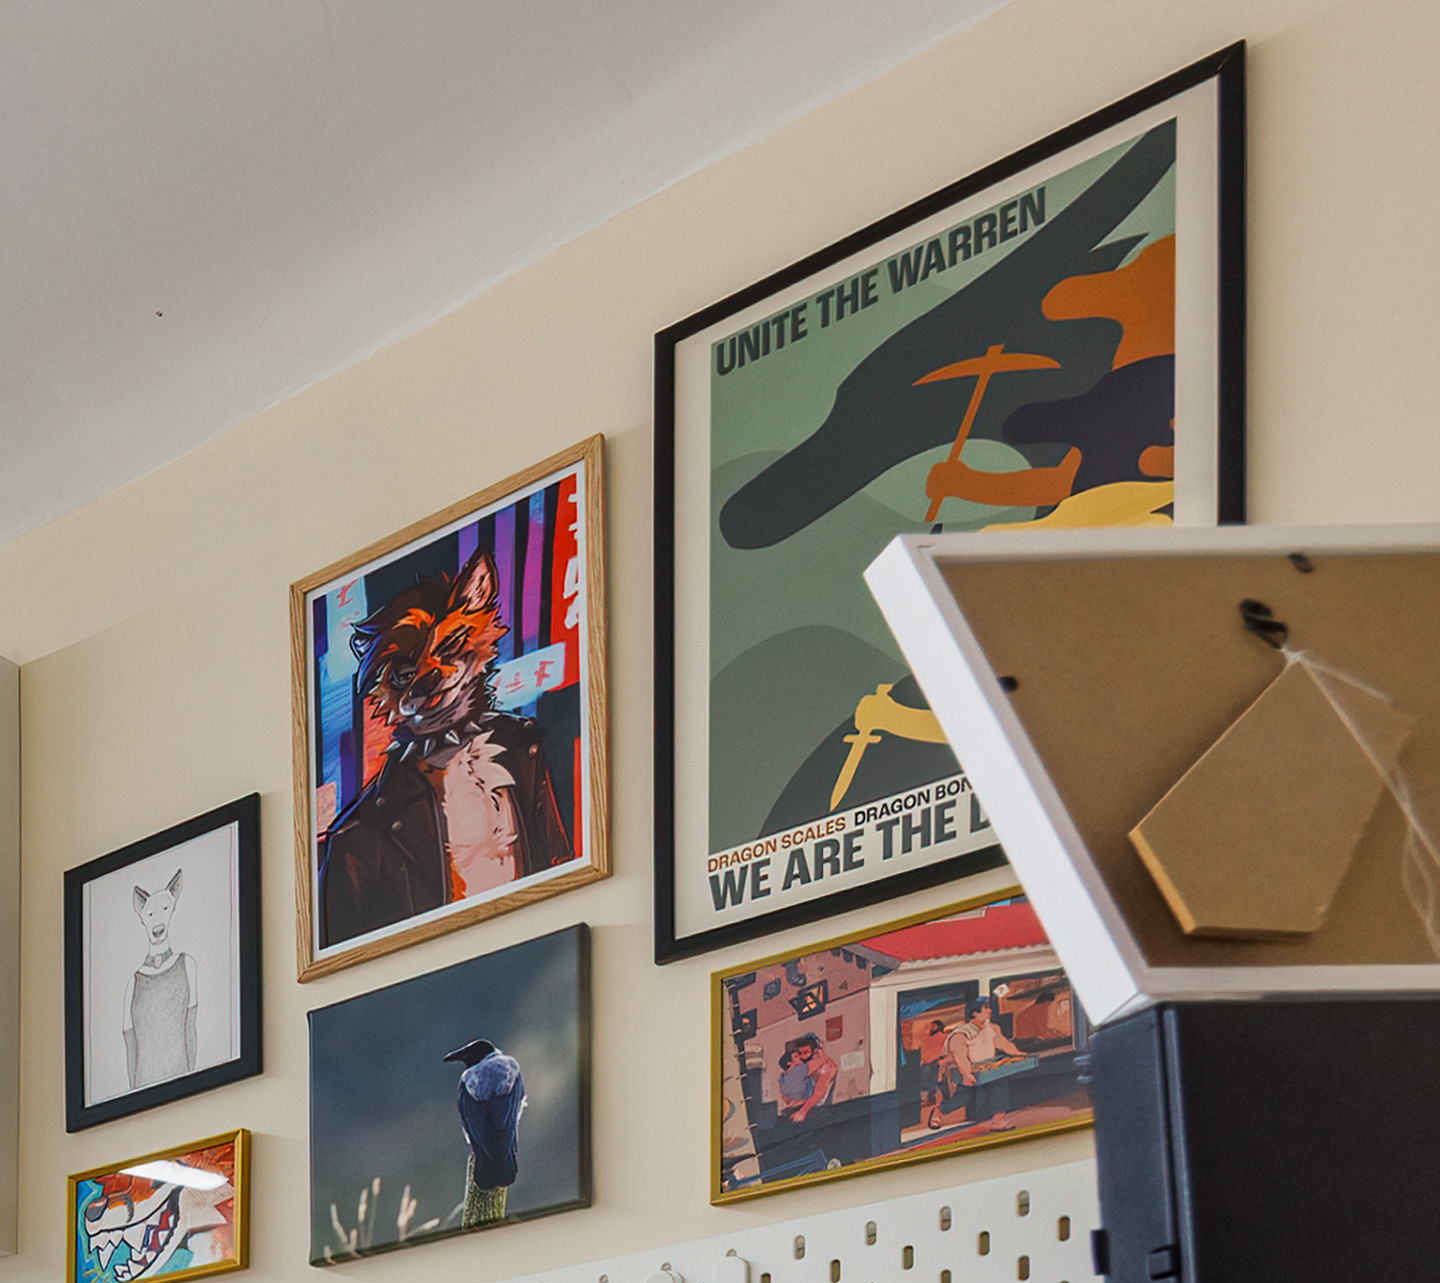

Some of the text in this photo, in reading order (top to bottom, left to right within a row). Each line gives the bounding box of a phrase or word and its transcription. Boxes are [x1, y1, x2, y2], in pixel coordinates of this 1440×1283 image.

[716, 186, 1046, 376] UNITE THE WARREN
[708, 839, 777, 873] DRAGON
[781, 817, 846, 849] SCALES
[854, 789, 930, 826] DRAGON
[709, 858, 771, 912] WE
[782, 829, 865, 891] ARE
[876, 800, 957, 861] THE
